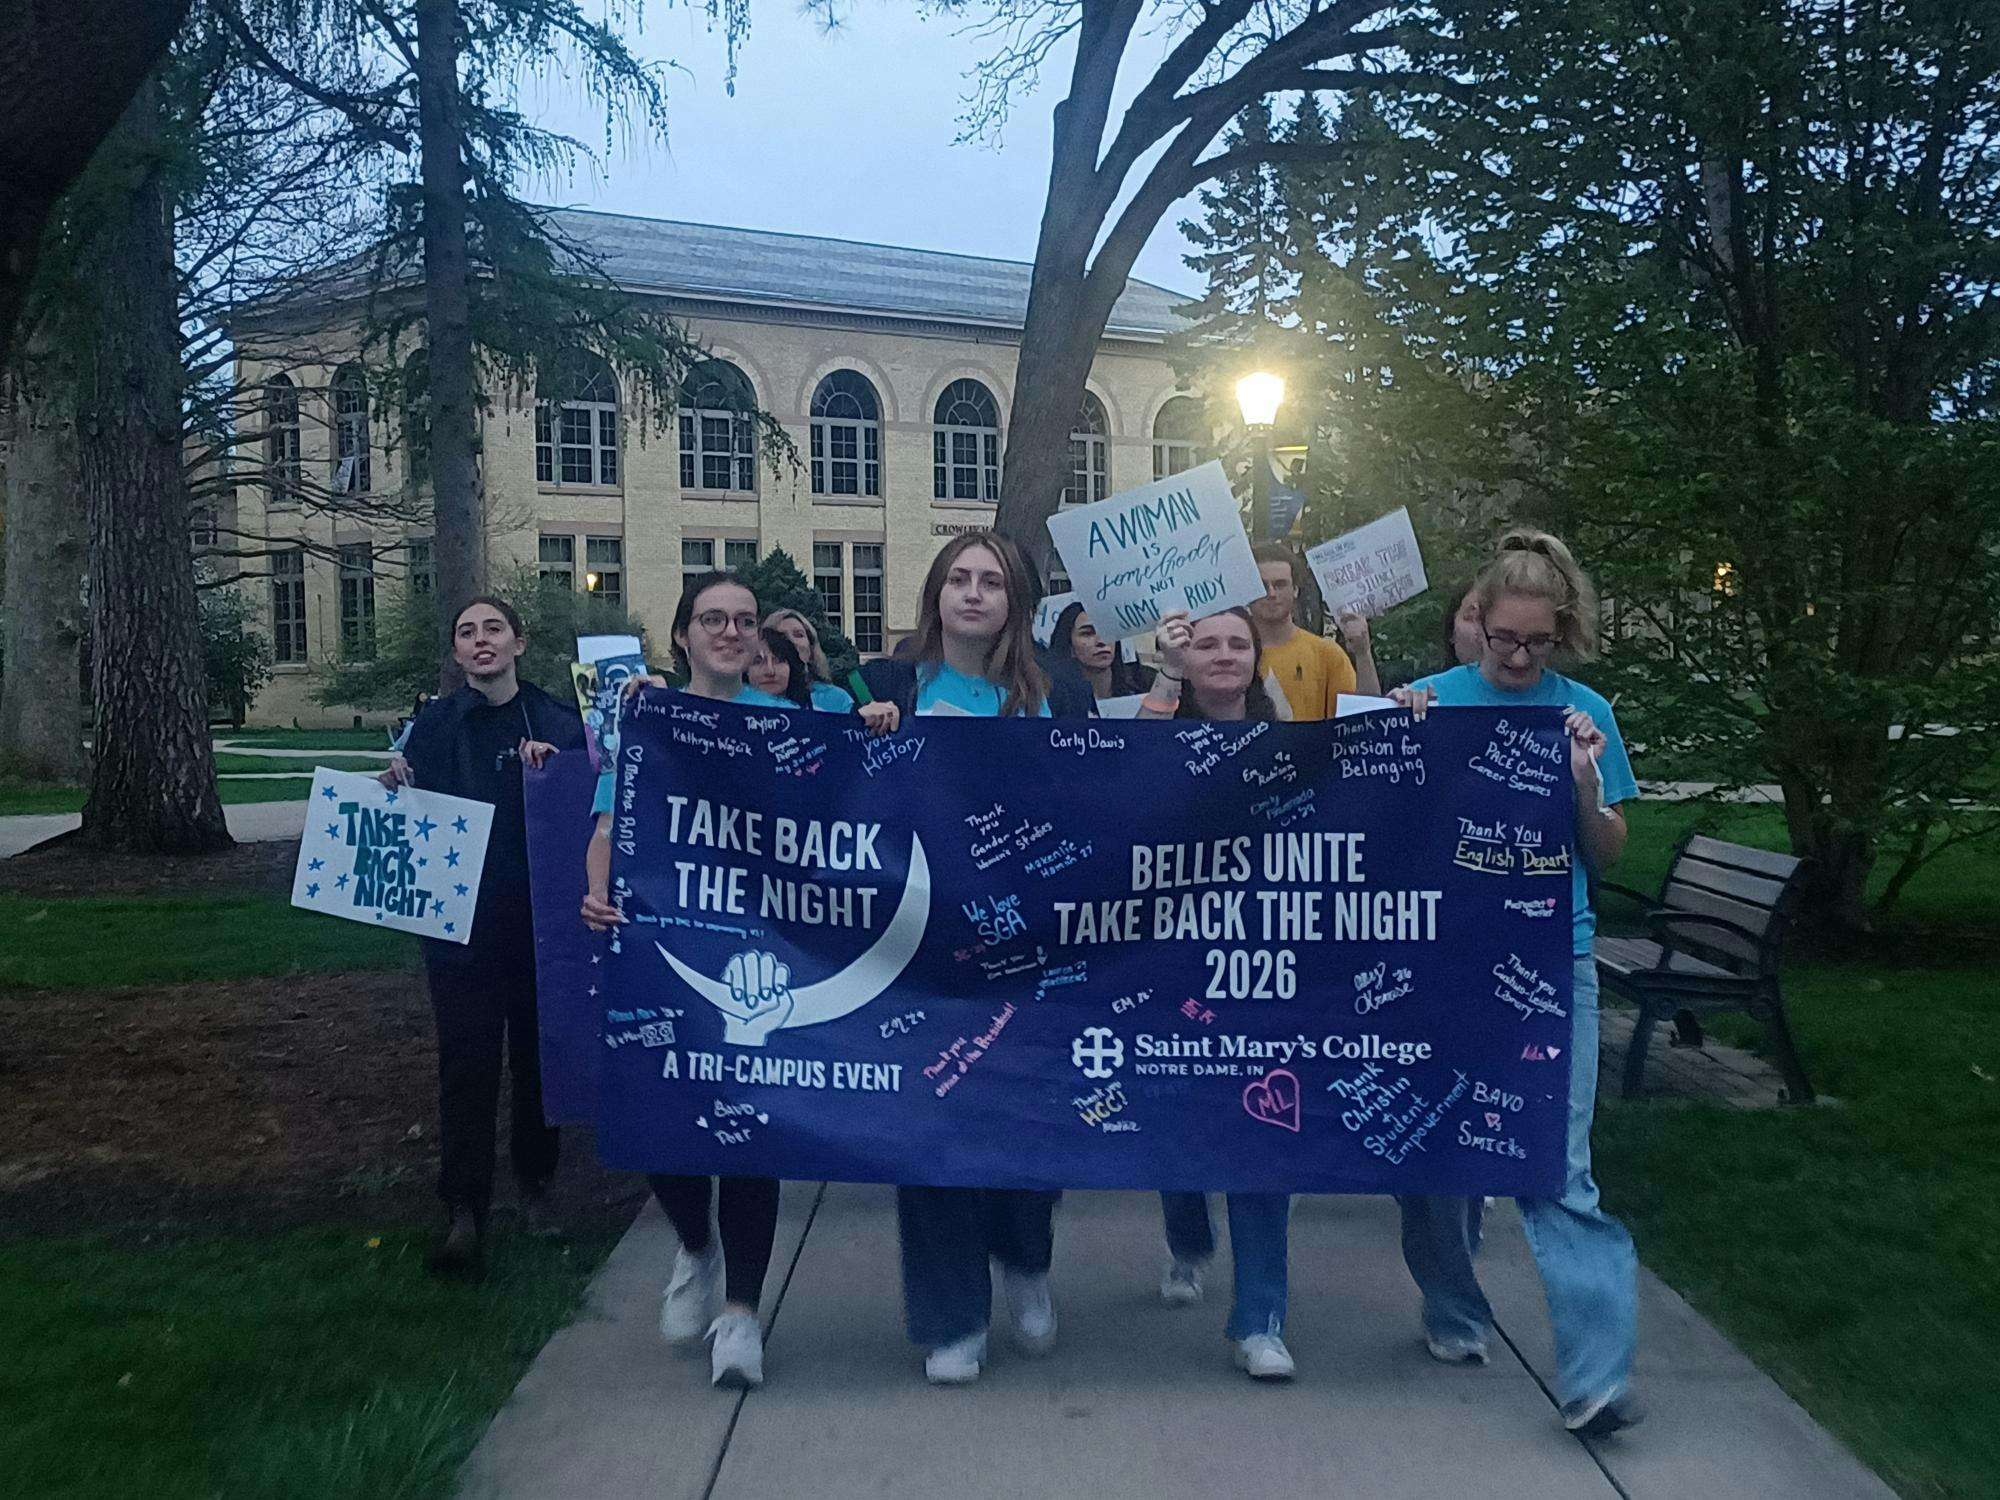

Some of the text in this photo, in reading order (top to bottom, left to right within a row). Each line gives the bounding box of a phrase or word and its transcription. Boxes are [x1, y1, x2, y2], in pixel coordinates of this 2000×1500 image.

[1087, 487, 1201, 558] A WOMAN
[1097, 533, 1236, 600] somebody
[1142, 542, 1161, 560] IS
[1150, 576, 1175, 594] NOT
[1184, 574, 1228, 611] BODY
[673, 726, 715, 755] Kathryn
[1050, 728, 1125, 756] Carly Davis
[1174, 722, 1215, 744] Thank
[1333, 716, 1409, 740] Thank you
[1495, 719, 1563, 765] Big thanks
[863, 733, 892, 760] you
[1190, 740, 1210, 755] you
[1332, 737, 1421, 760] Division for
[1485, 741, 1559, 783] PACE Center
[1185, 752, 1221, 777] Psych
[1340, 758, 1425, 786] Belonging
[1468, 756, 1551, 796] Career Services
[338, 802, 409, 848] TAKE
[964, 803, 1006, 827] Thank
[979, 820, 1000, 836] you
[1457, 817, 1507, 839] Thank
[667, 794, 882, 870] TAKE BACK
[970, 833, 1010, 857] Gender
[353, 845, 416, 886] BACK
[1132, 832, 1365, 891] BELLES UNITE
[1456, 840, 1515, 870] English
[353, 875, 432, 918] NIGHT
[674, 861, 748, 915] THE
[760, 874, 878, 929] NIGHT
[962, 894, 1021, 923] We love
[977, 909, 1028, 946] SGA
[1053, 890, 1442, 945] TAKE BACK THE NIGHT
[1205, 948, 1297, 999] 2026
[1508, 953, 1538, 984] Thank
[1494, 985, 1535, 1022] Library
[1135, 1033, 1432, 1065] Saint Mary's College
[663, 1051, 902, 1092] A TRI-CAMPUS EVENT
[1135, 1062, 1264, 1077] NOTRE DAME, IN
[1326, 1062, 1384, 1098] Thank
[1257, 1088, 1294, 1116] ML
[1351, 1083, 1379, 1108] you
[1472, 1081, 1524, 1112] BAVO
[1364, 1093, 1429, 1156] Student
[1385, 1068, 1470, 1165] Empowerment
